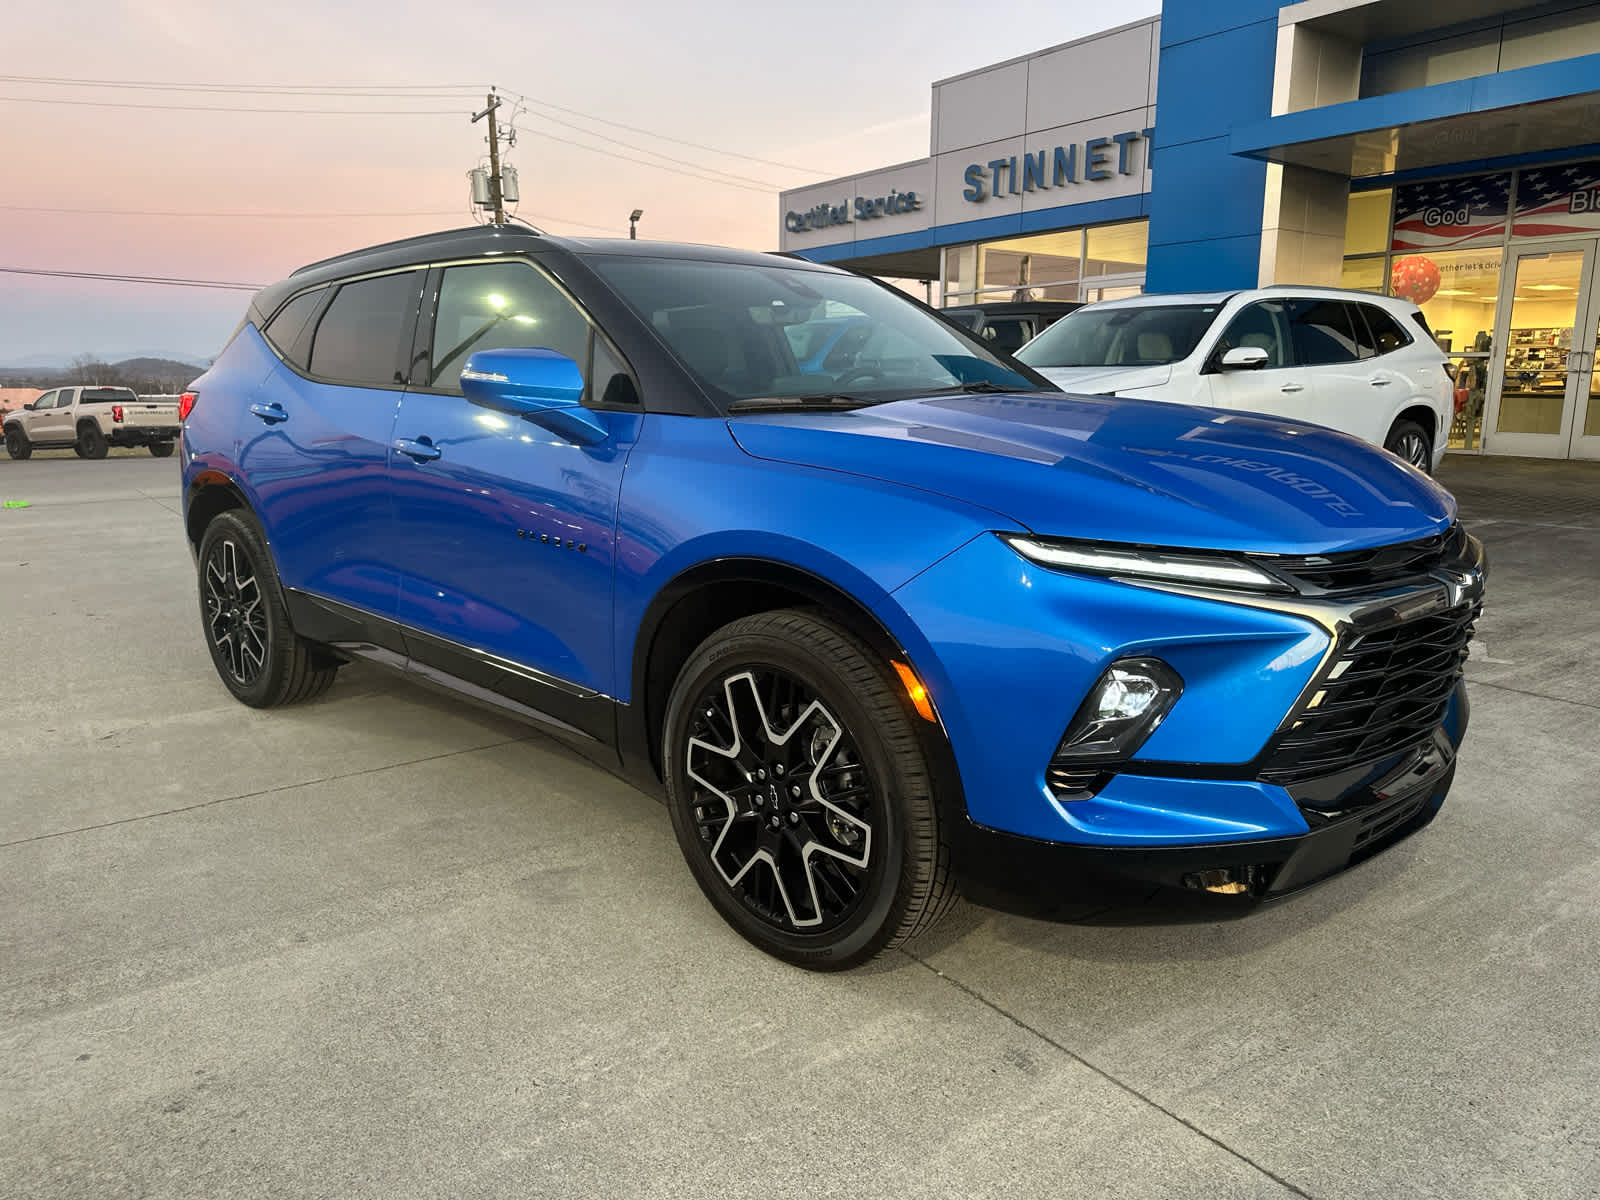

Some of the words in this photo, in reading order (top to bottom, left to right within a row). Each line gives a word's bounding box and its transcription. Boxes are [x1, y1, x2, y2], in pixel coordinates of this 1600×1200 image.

[785, 200, 849, 233] Certified
[854, 189, 919, 220] Service
[1423, 204, 1470, 227] God
[1439, 263, 1464, 272] ether
[1485, 260, 1502, 270] driv
[517, 529, 587, 552] BLAZER
